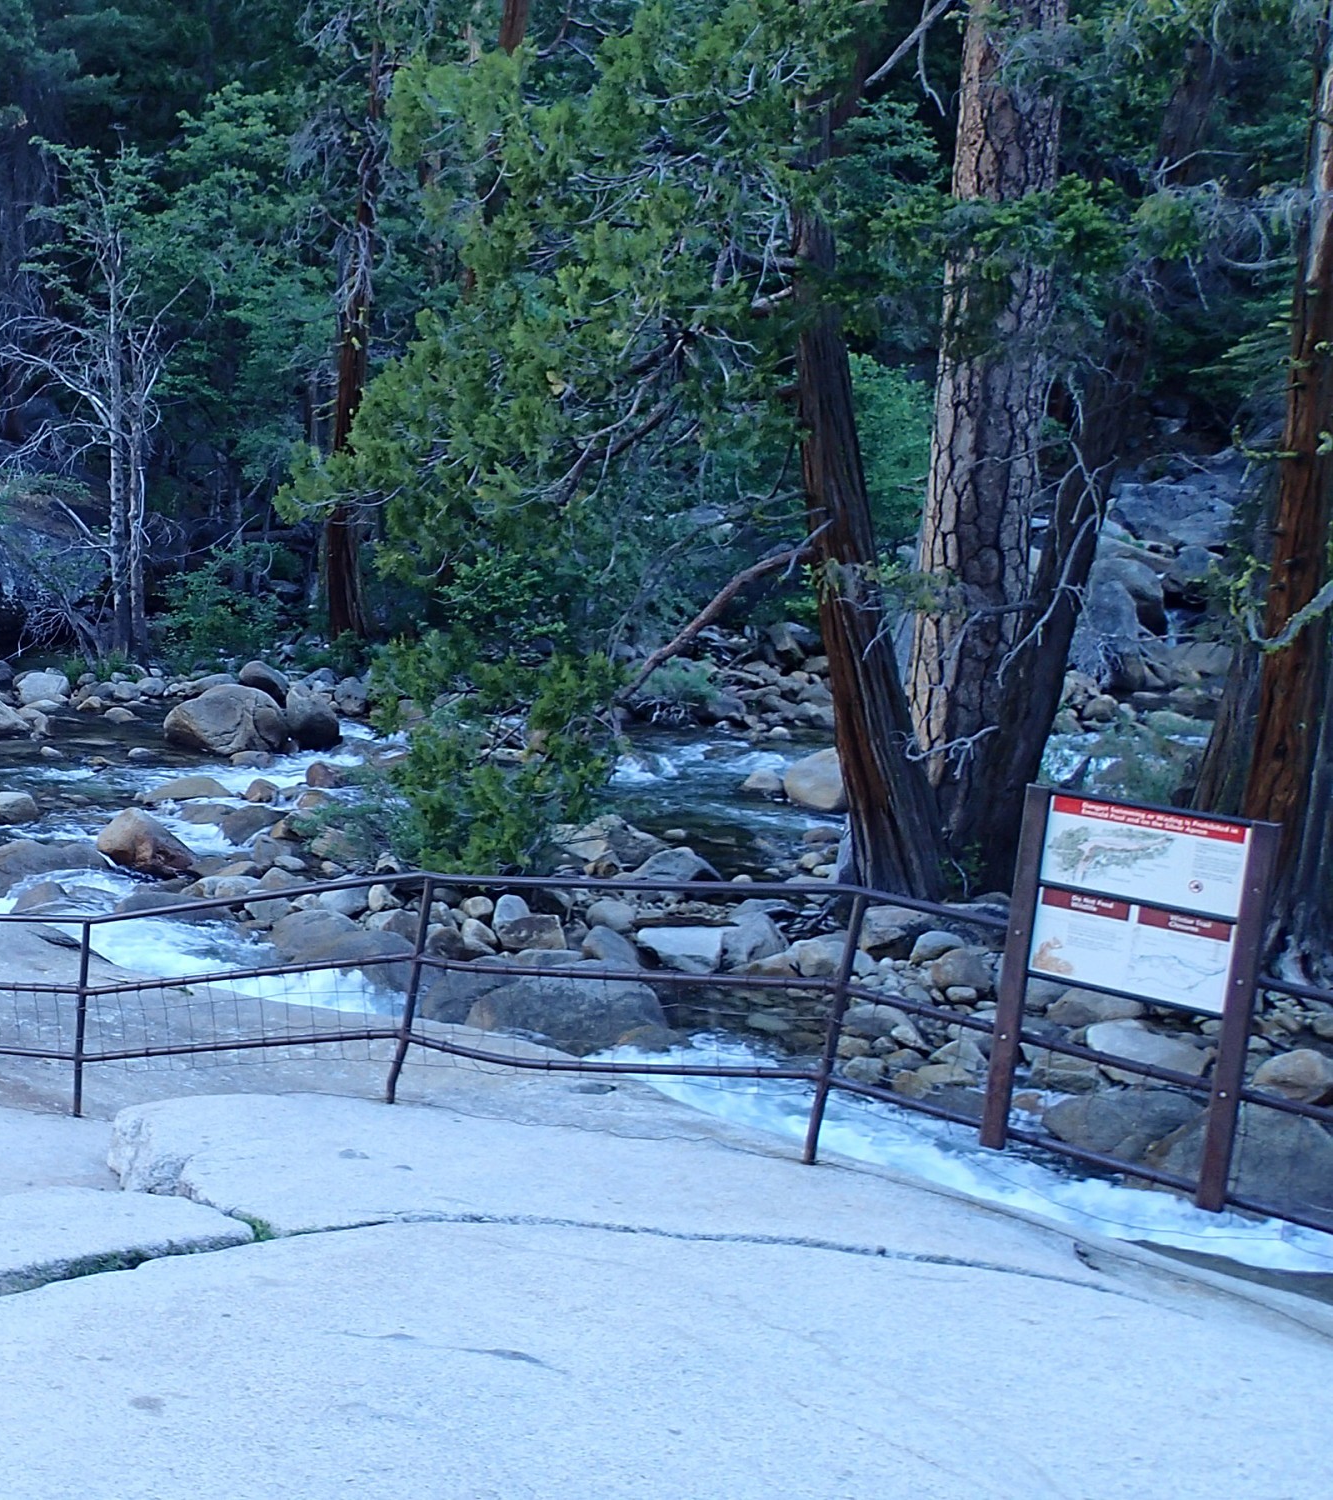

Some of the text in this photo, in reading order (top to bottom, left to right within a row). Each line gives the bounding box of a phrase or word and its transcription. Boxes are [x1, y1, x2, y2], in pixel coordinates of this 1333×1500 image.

[1109, 813, 1125, 821] Pool
[1126, 816, 1140, 824] and
[1156, 815, 1183, 826] Wading
[1192, 820, 1230, 833] Prohibited
[1071, 894, 1082, 902] Do
[1097, 899, 1114, 909] Feed
[1169, 914, 1212, 928] Winter Trail
